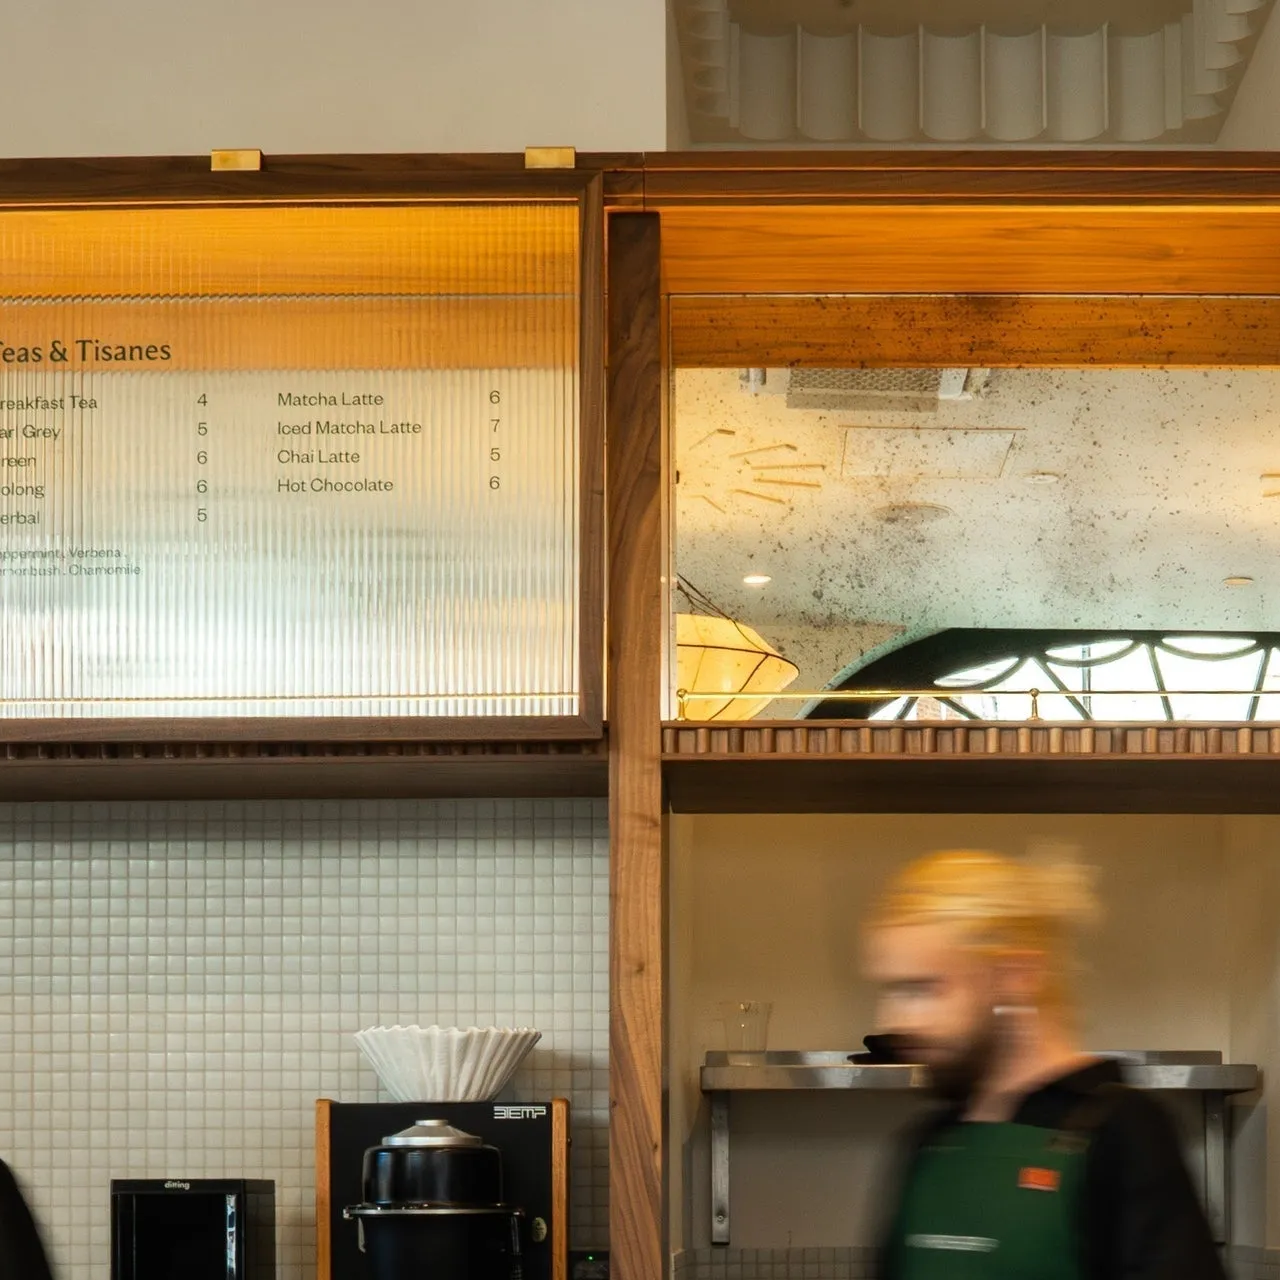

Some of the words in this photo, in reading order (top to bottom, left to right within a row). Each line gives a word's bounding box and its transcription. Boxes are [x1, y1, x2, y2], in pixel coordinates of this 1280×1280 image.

[50, 340, 68, 362] &
[75, 339, 172, 362] Tisanes
[69, 395, 98, 409] Tea
[196, 393, 209, 407] 4
[277, 392, 338, 406] Matcha
[341, 392, 384, 406] Latte
[489, 390, 501, 404] 6
[22, 424, 61, 441] Grey
[197, 422, 208, 436] 5
[277, 420, 312, 435] Iced
[315, 420, 376, 435] Matcha
[379, 420, 422, 434] Latte
[490, 418, 501, 432] 7
[197, 451, 208, 465] 6
[277, 449, 315, 464] Chai
[318, 449, 361, 464] Latte
[490, 448, 501, 462] 5
[197, 479, 208, 494] 6
[277, 478, 306, 493] Hot
[310, 478, 394, 493] Chocolate
[489, 476, 501, 490] 6
[197, 508, 208, 522] 5
[69, 563, 141, 577] Chamomile
[164, 1180, 190, 1190] ditting
